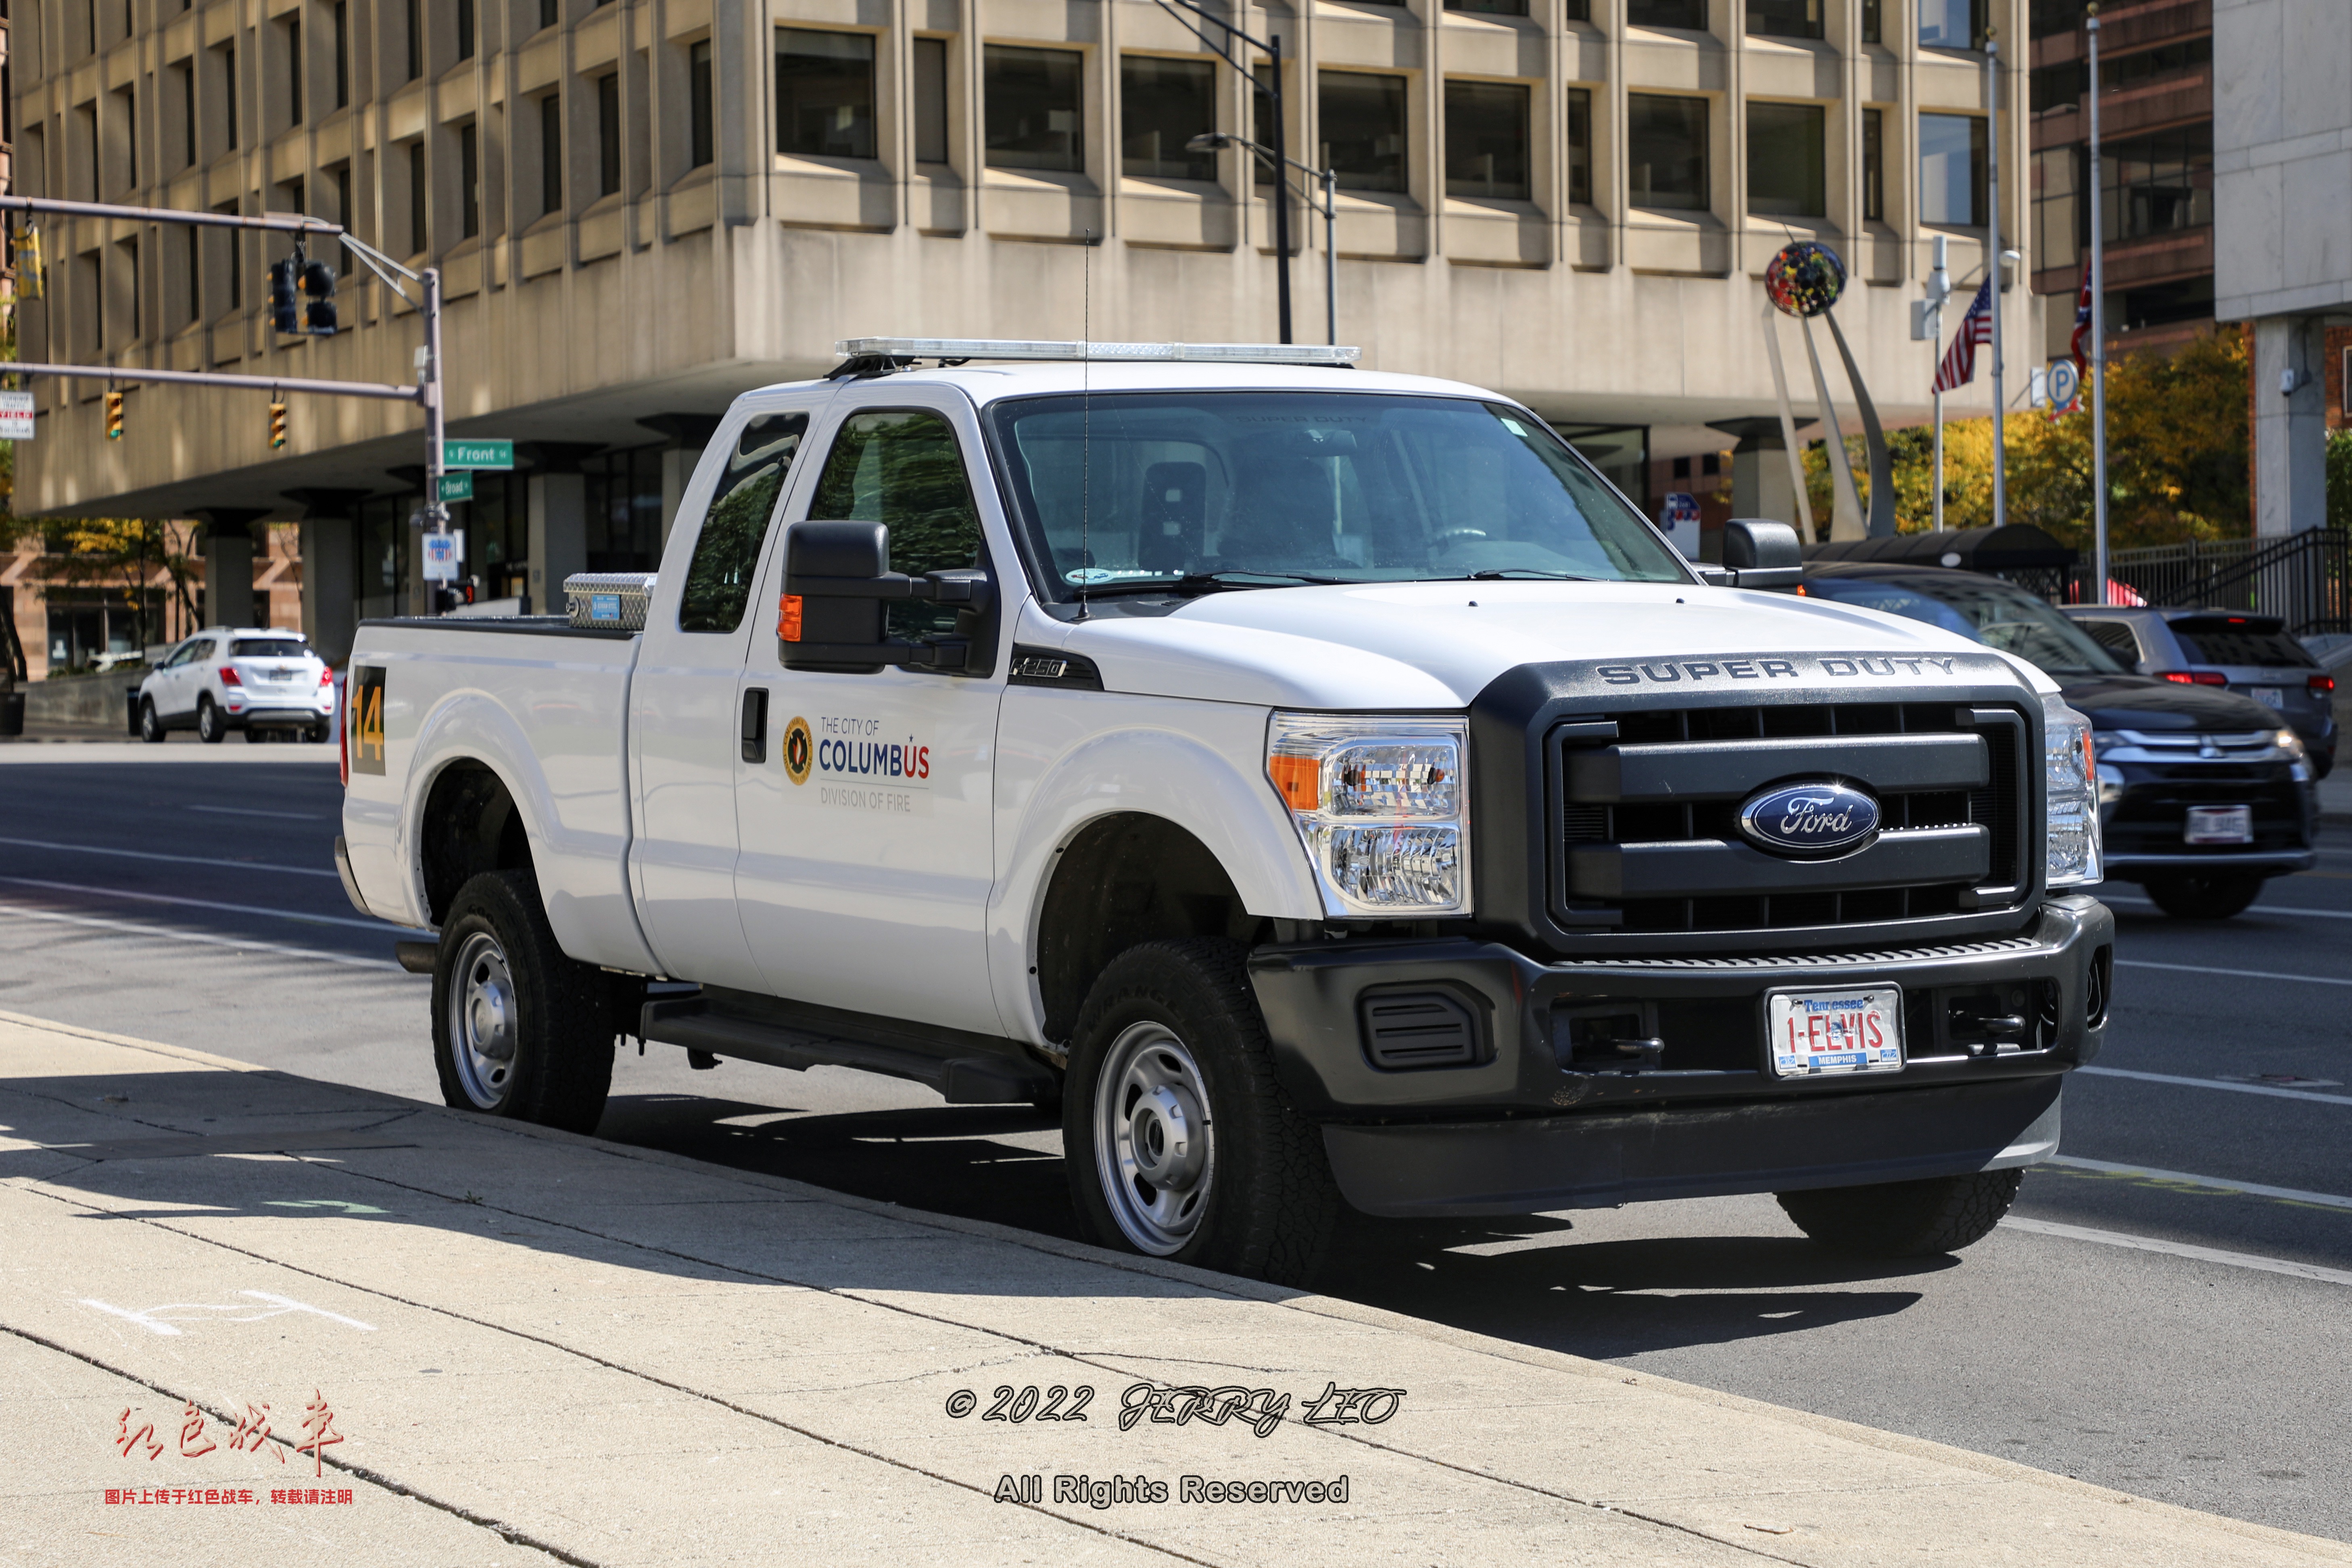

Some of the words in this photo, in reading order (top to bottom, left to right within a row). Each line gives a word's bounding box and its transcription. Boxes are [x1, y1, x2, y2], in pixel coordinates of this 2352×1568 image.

[2056, 370, 2070, 397] P
[458, 446, 495, 461] Front
[445, 479, 463, 496] Broad
[1596, 658, 1799, 685] SUPER
[1817, 656, 1954, 676] DUTY
[352, 685, 384, 761] 14
[821, 717, 839, 733] THE
[841, 718, 863, 735] CITY
[865, 720, 879, 736] OF
[819, 739, 929, 779] COLUMBUS
[821, 787, 866, 808] DIVISION
[870, 791, 883, 810] OF
[887, 793, 910, 812] FIRE
[1780, 797, 1854, 835] Ford
[1804, 999, 1864, 1012] Tennessee
[1787, 1010, 1883, 1053] 1-ELVIS
[1818, 1054, 1857, 1065] MEMPHIS
